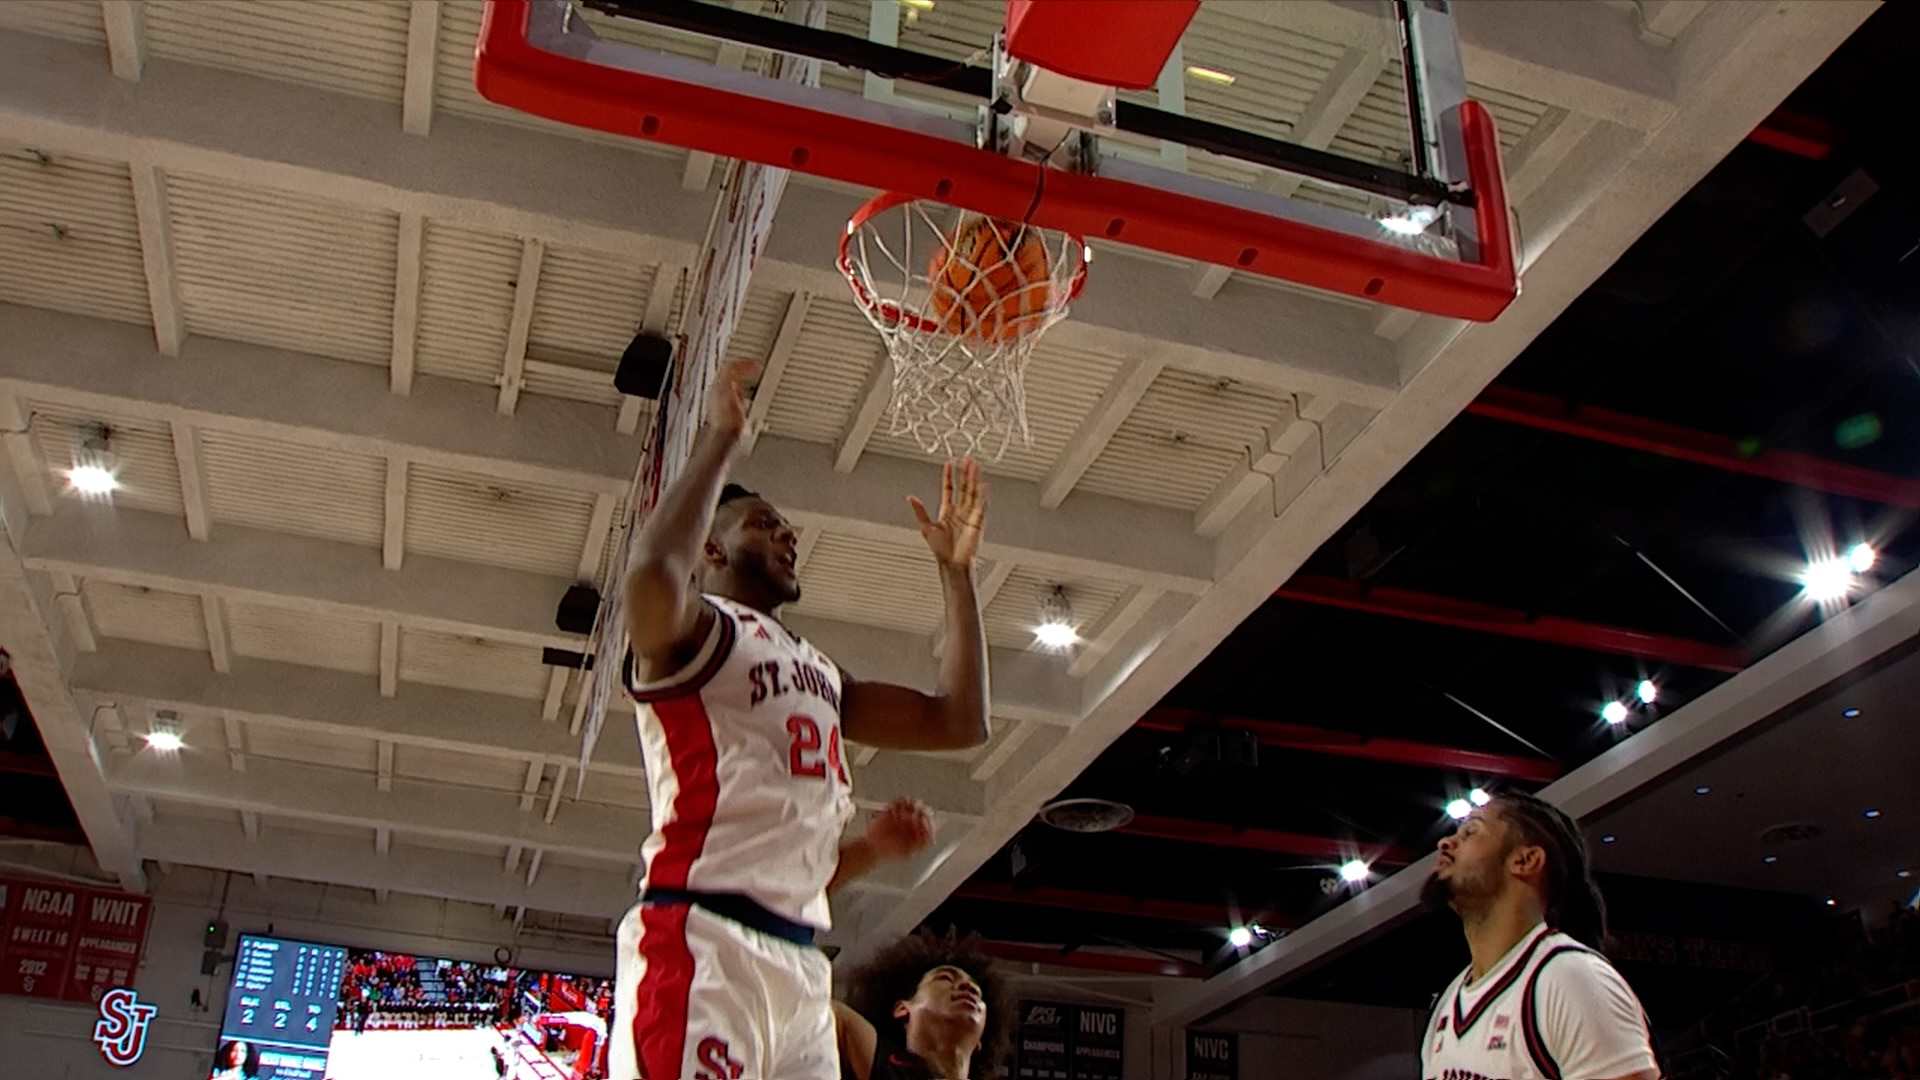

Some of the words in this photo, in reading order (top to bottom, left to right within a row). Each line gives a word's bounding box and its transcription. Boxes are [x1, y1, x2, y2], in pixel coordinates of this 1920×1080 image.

[748, 660, 788, 707] ST.
[785, 713, 849, 786] 24
[21, 887, 75, 917] NCAA
[90, 897, 143, 926] WNIT
[12, 925, 51, 945] SWEET
[55, 931, 69, 947] 16
[18, 958, 48, 976] 2012
[241, 1008, 255, 1024] 2
[274, 1012, 288, 1028] 2
[305, 1016, 318, 1032] 4
[1080, 1010, 1117, 1035] NIVC
[1194, 1036, 1229, 1060] NIVC
